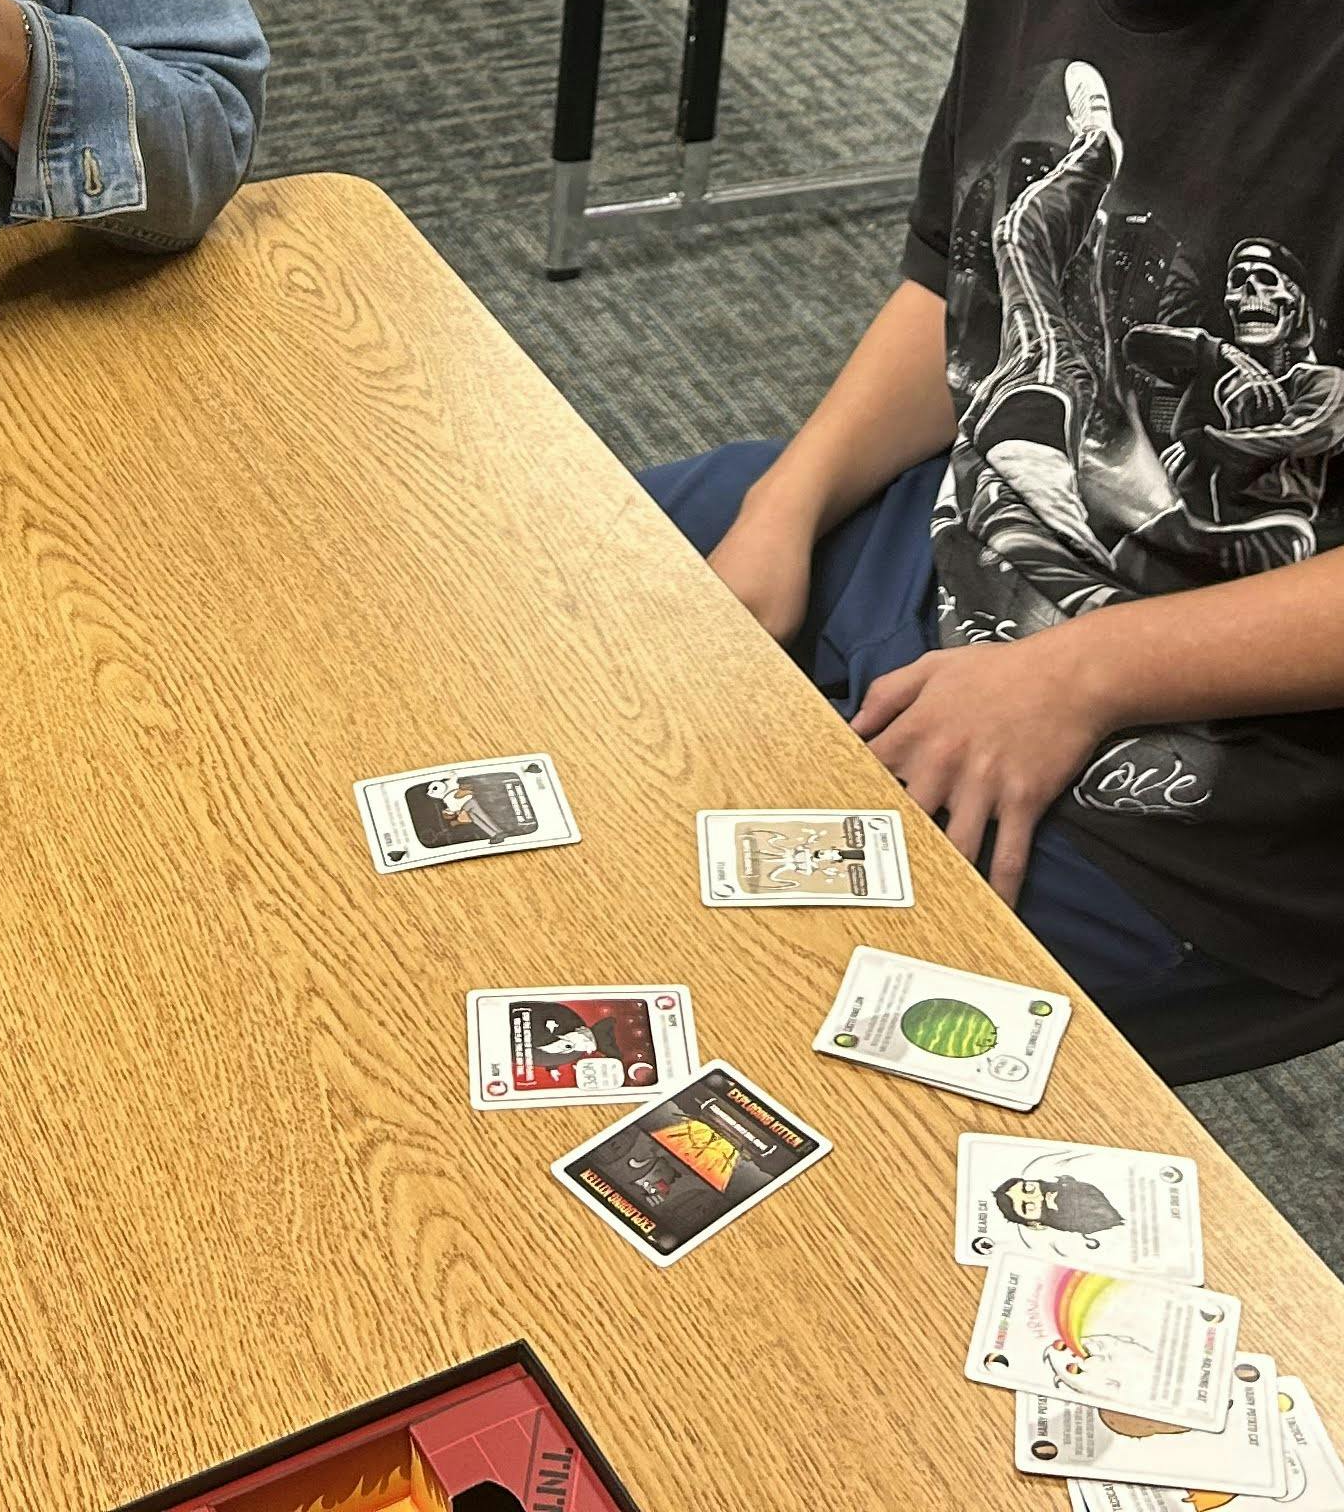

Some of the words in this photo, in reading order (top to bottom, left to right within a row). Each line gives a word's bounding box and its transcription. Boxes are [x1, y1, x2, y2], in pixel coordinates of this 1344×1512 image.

[727, 1087, 775, 1127] EXPLODING
[769, 1118, 805, 1149] KITTEN
[579, 1167, 614, 1199] KITTEN
[607, 1191, 656, 1233] EXPLODING
[978, 1213, 988, 1234] BEARD
[1037, 1417, 1048, 1436] HAIRY
